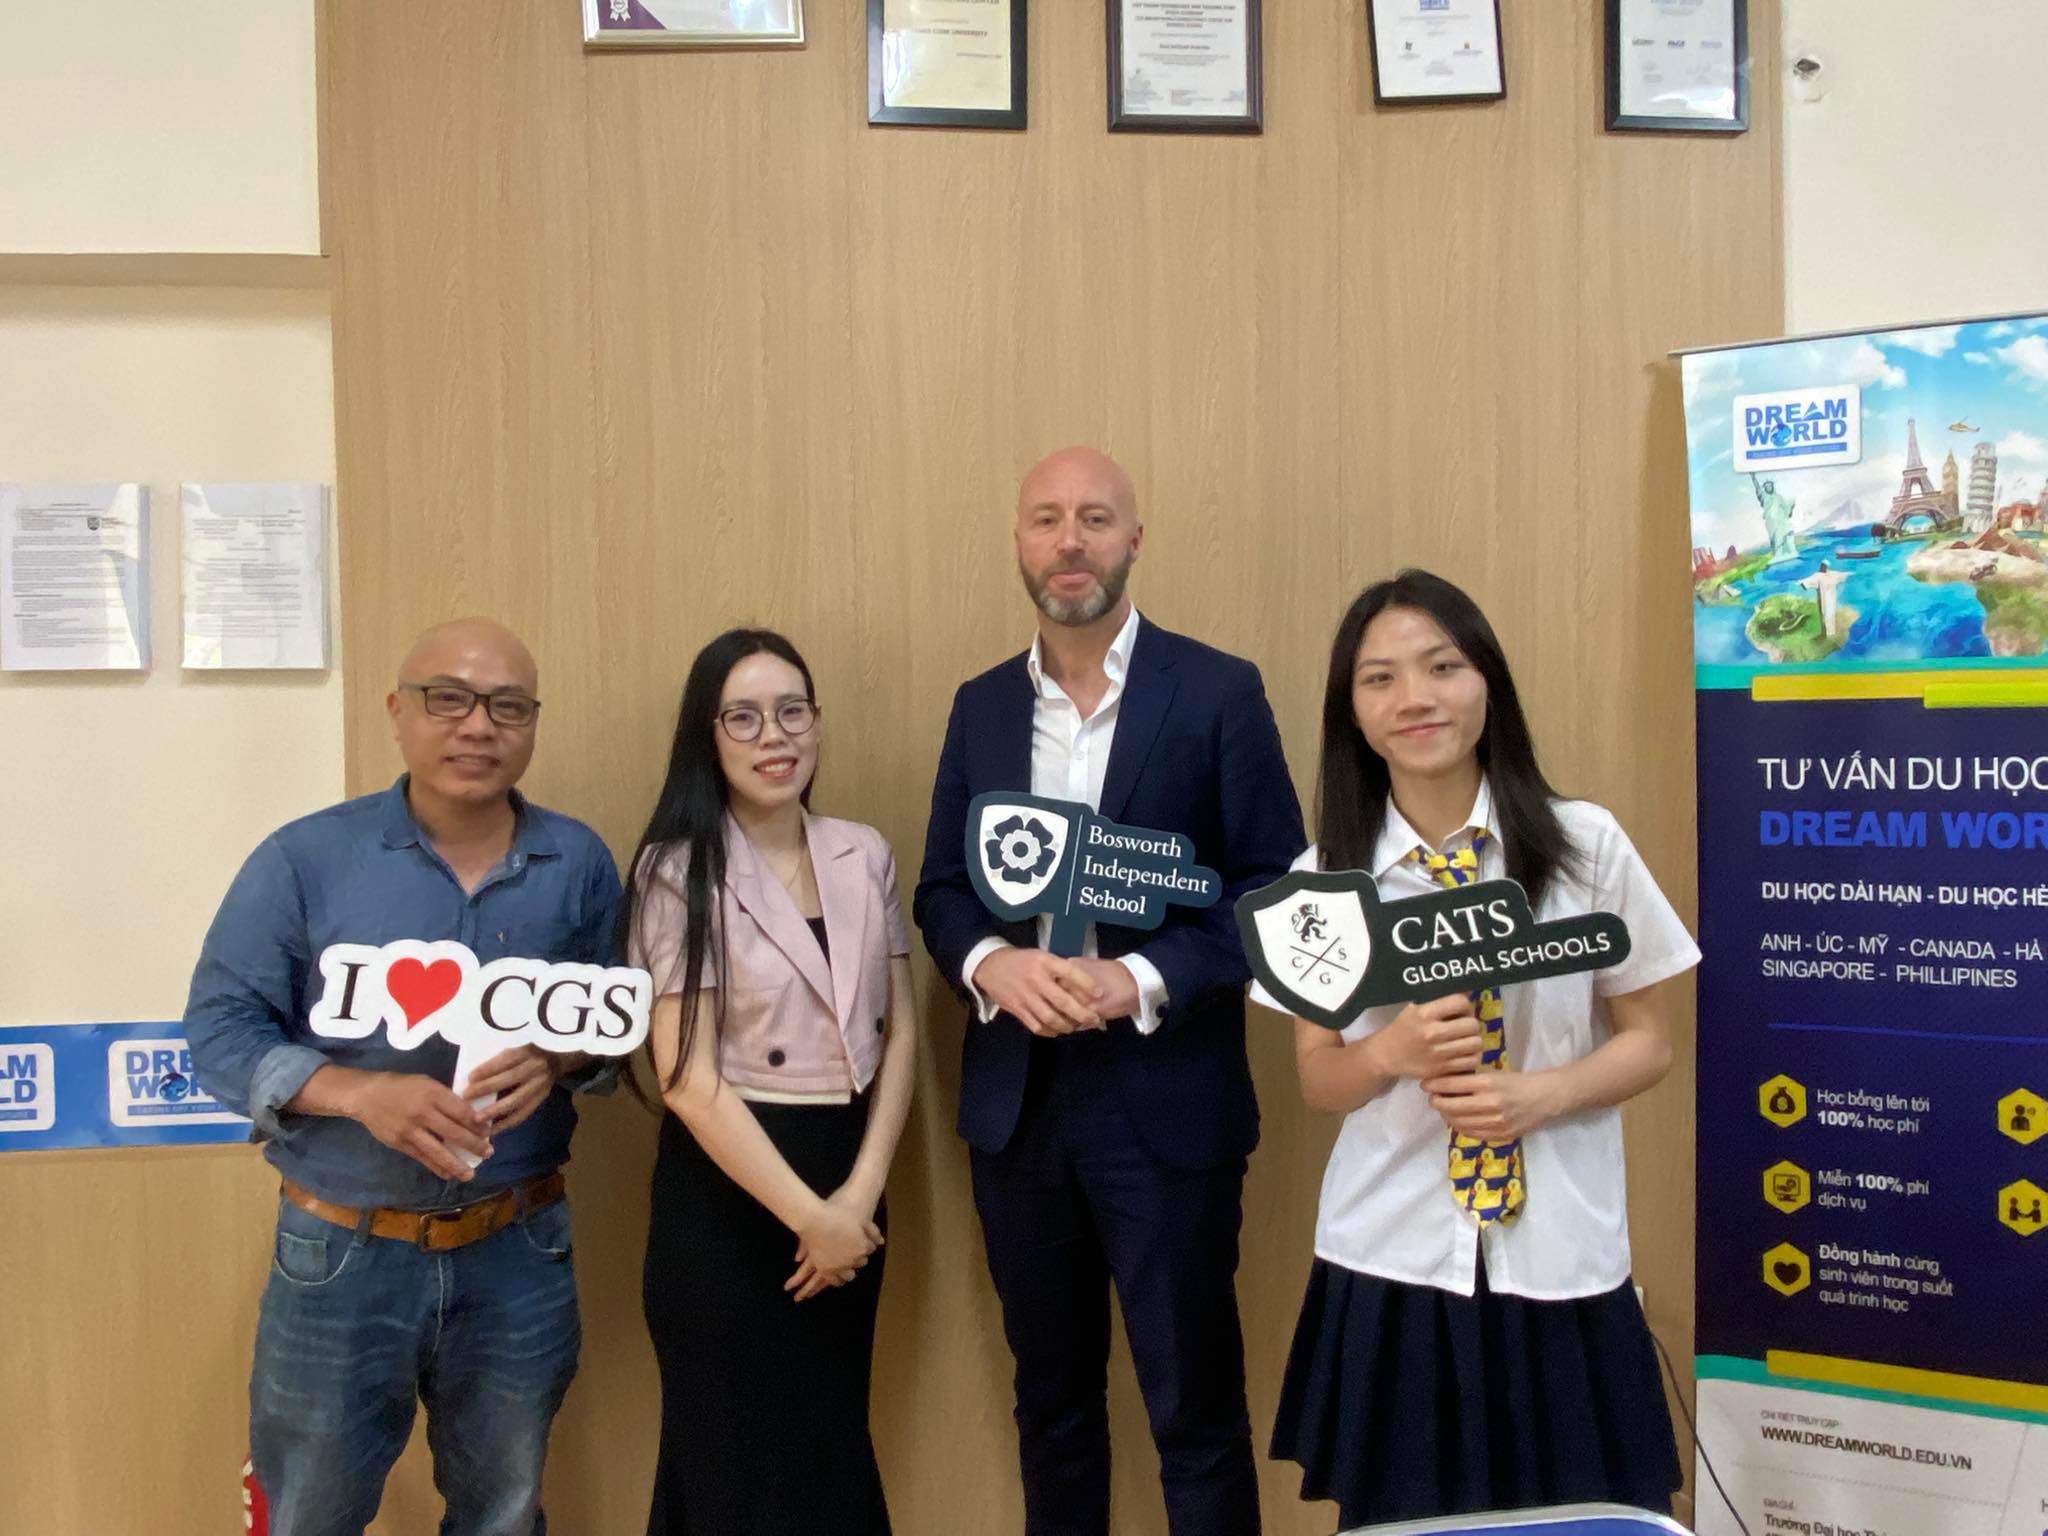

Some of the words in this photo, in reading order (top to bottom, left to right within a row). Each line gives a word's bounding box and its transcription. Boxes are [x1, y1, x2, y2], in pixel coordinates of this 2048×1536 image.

[1745, 398, 1847, 427] DREAM
[1746, 420, 1847, 447] WORLD
[1757, 757, 1812, 790] TƯ
[1820, 750, 1896, 790] VẤN
[1908, 757, 1962, 791] DU
[1974, 756, 2048, 796] HỌC
[1088, 824, 1182, 858] Bosworth
[1759, 810, 1928, 848] DREAM
[1083, 855, 1210, 894] Independent
[1080, 886, 1146, 915] School
[1761, 881, 1789, 900] DU
[1794, 882, 1836, 905] HỌC
[1840, 880, 1874, 902] DÀI
[1878, 884, 1922, 907] HẠN
[1938, 886, 1968, 905] DU
[1973, 887, 2018, 910] HỌC
[1391, 899, 1515, 953] CATS
[1402, 955, 1494, 985] GLOBAL
[1497, 932, 1611, 969] SCHOOLS
[1760, 933, 1801, 952] ANH
[1816, 930, 1844, 953] ÚC
[1859, 933, 1890, 955] MỸ
[1910, 938, 1996, 959] CANADA
[1762, 959, 1875, 980] SINGAPORE
[1896, 965, 2018, 988] PHILLIPINES
[330, 962, 369, 1022] I
[480, 975, 637, 1039] CGS
[1816, 1089, 1845, 1107] Học
[1886, 1094, 1908, 1110] lên
[1817, 1110, 1864, 1128] 100%
[1867, 1114, 1894, 1132] học
[1856, 1174, 1903, 1193] 100%
[1907, 1180, 1930, 1196] phí
[1818, 1191, 1846, 1209] dịch
[1849, 1198, 1867, 1212] vụ
[1819, 1242, 1859, 1266] Đồng
[1863, 1249, 1901, 1268] hành
[1819, 1267, 1847, 1283] sinh
[1851, 1270, 1880, 1286] viên
[1883, 1274, 1919, 1295] trong
[1882, 1294, 1910, 1313] học
[1761, 1426, 1972, 1470] WWW.DREAMWORLD.EDU.VN
